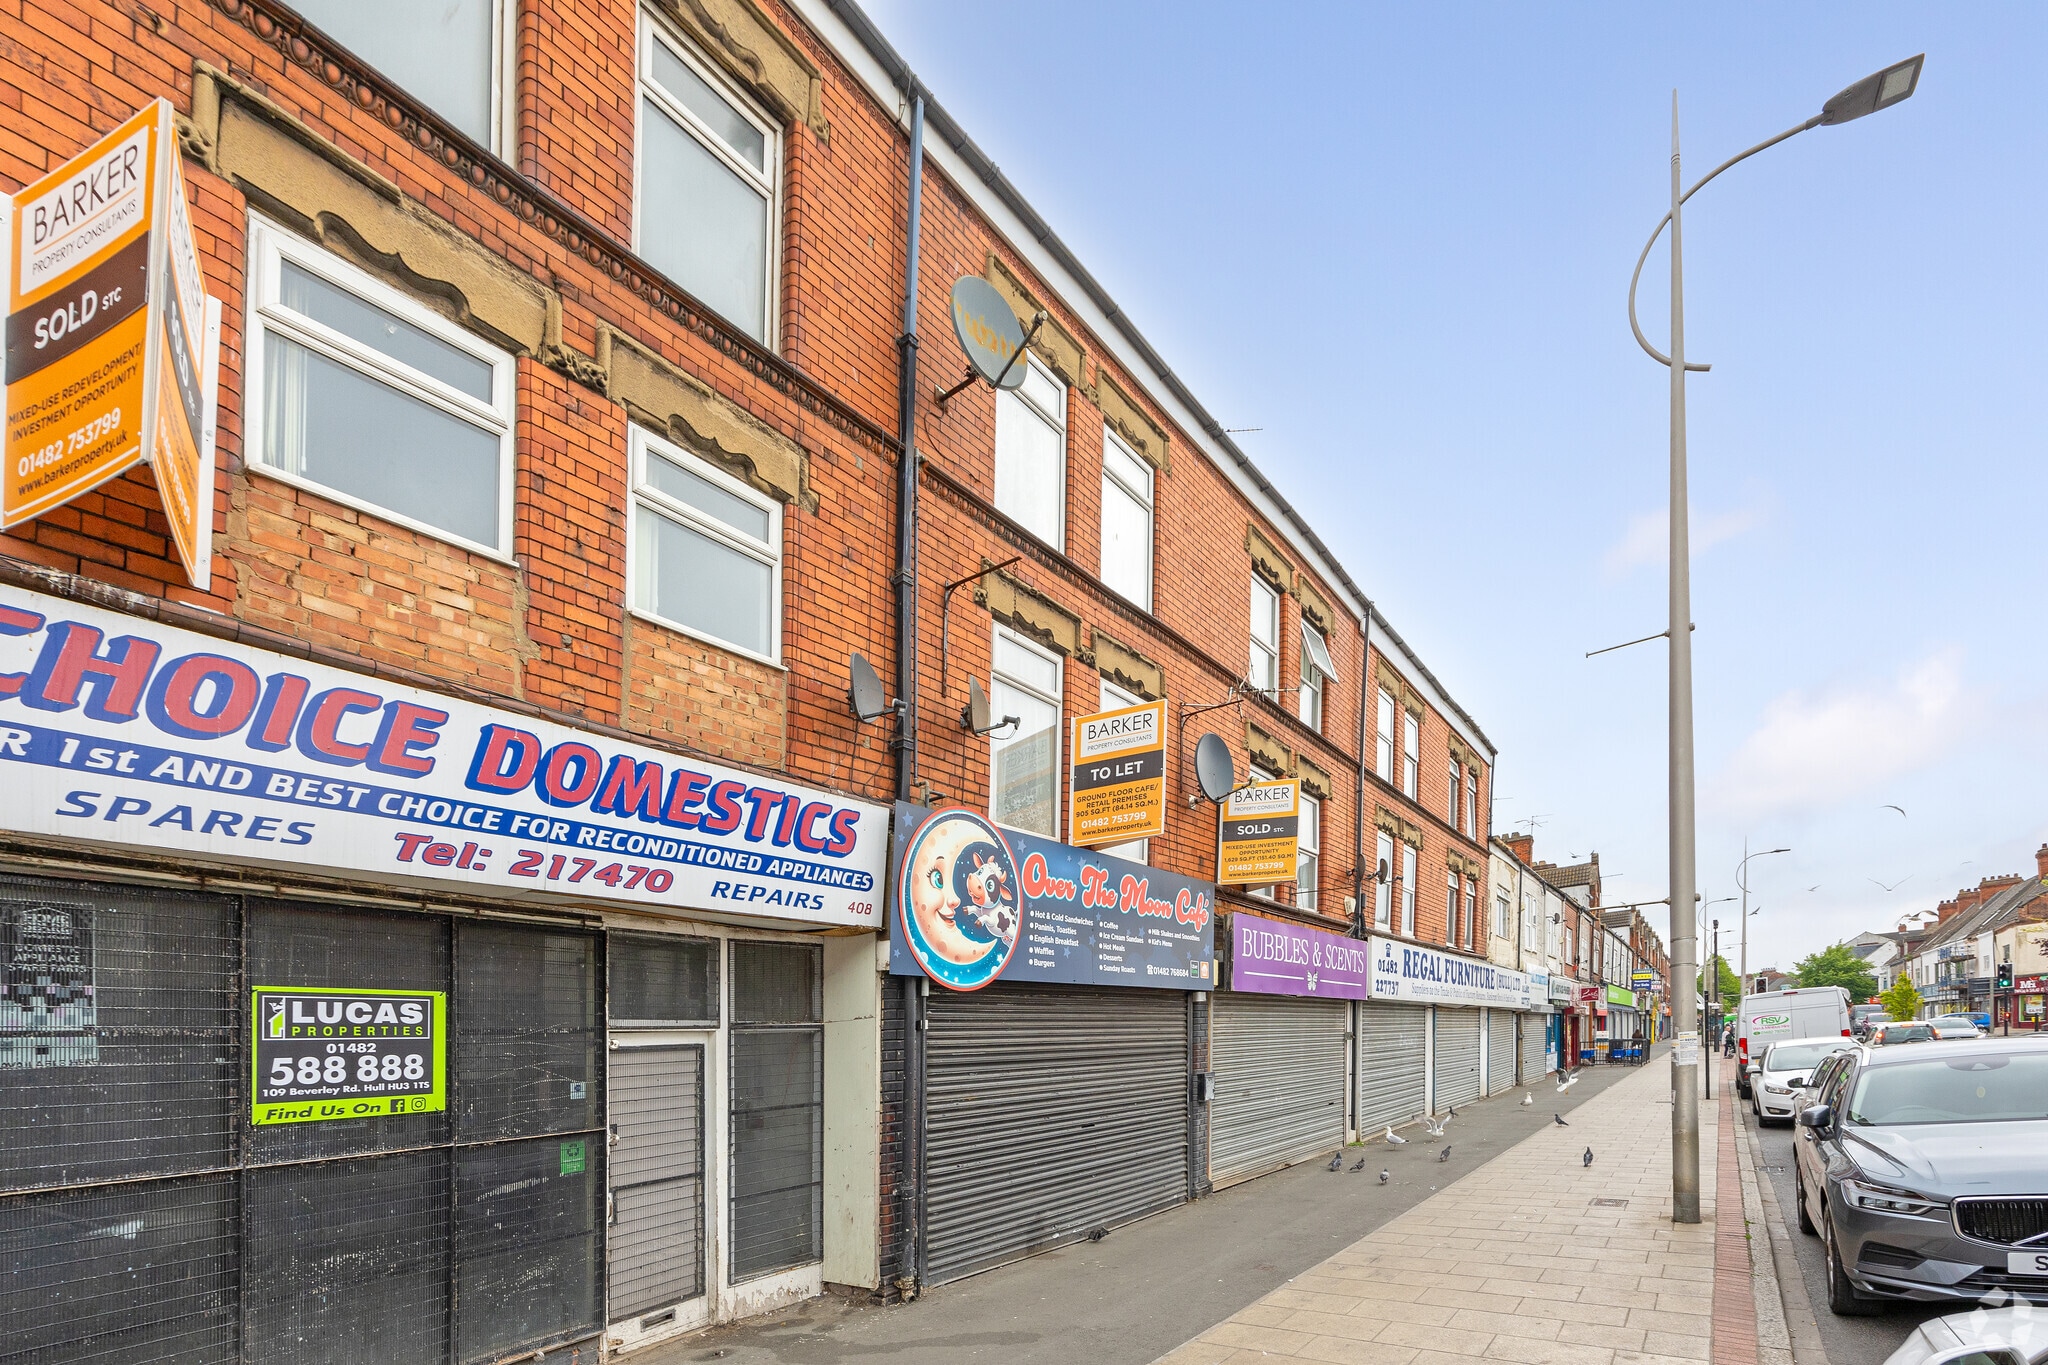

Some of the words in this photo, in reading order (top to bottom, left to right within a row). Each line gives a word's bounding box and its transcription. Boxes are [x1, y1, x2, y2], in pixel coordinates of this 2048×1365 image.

[34, 144, 138, 245] BARKER
[32, 240, 75, 276] PROPERTY
[77, 199, 136, 250] CONSULTANTS
[34, 290, 98, 349] SOLD
[102, 287, 122, 310] STC
[8, 392, 59, 427] MIXED-USE
[62, 338, 145, 399] REDEVELOPMENT/
[12, 403, 71, 442] INVESTMENT
[74, 363, 138, 412] OPPORTUNITY
[18, 440, 63, 476] 01482
[67, 407, 121, 455] 753799
[18, 430, 128, 496] www.barkerproperty.uk
[1088, 713, 1153, 740] BARKER
[1087, 741, 1113, 751] PROPERTY
[1114, 734, 1153, 746] CONSULTANTS
[1090, 766, 1111, 781] TO
[1115, 760, 1144, 777] LET
[465, 723, 861, 858] DOMESTICS
[1077, 792, 1107, 803] GROUND
[1109, 787, 1133, 797] FLOOR
[1135, 783, 1159, 792] CAFE/
[1235, 787, 1290, 803] BARKER
[1076, 809, 1089, 818] 905
[1090, 806, 1110, 815] SQ.FT
[1112, 803, 1133, 812] (84.14
[1135, 799, 1159, 808] SQ.M.)
[1086, 799, 1110, 808] RETAIL
[1112, 793, 1148, 804] PREMISES
[1257, 803, 1289, 811] CONSULTANTS
[55, 790, 316, 846] SPARES
[59, 738, 140, 773] 1st
[151, 755, 252, 791] AND
[266, 773, 371, 809] BEST
[377, 792, 503, 830] CHOICE
[510, 815, 570, 842] FOR
[576, 827, 761, 872] RECONDITIONED
[766, 859, 872, 890] APPLIANCES
[1081, 817, 1109, 829] 01482
[1112, 811, 1146, 824] 753799
[1081, 820, 1152, 836] www.barkerproperty.uk
[1237, 824, 1271, 835] SOLD
[1225, 842, 1256, 850] MIXED-USE
[1238, 848, 1280, 856] OPPORTUNITY
[394, 832, 493, 871] Tel:
[508, 848, 674, 894] 217470
[1228, 863, 1252, 872] 01482
[1254, 861, 1285, 871] 753799
[1228, 868, 1288, 877] www.barkerproperty.uk
[710, 880, 825, 911] REPAIRS
[1022, 852, 1077, 900] Over
[1081, 864, 1118, 909] The
[1119, 874, 1174, 919] Moon
[1175, 887, 1210, 932] Café
[847, 901, 872, 916] 408
[1034, 910, 1046, 919] Hot
[1046, 912, 1051, 920] &
[1051, 912, 1064, 922] Cold
[1064, 915, 1094, 926] Sandwiches
[1103, 921, 1119, 930] Coffee
[1034, 922, 1056, 933] Paninis,
[1056, 925, 1077, 935] Toasties
[1160, 930, 1174, 938] Shakes
[1181, 933, 1201, 942] Smoothies
[1034, 934, 1055, 944] English
[1055, 936, 1079, 947] Breakfast
[1103, 932, 1111, 940] Ice
[1111, 933, 1126, 942] Cream
[1126, 935, 1144, 944] Sundaes
[1161, 940, 1173, 948] Menu
[1033, 946, 1055, 956] Waffles
[1112, 943, 1126, 952] Meals
[1242, 927, 1309, 966] BUBBLES
[1312, 941, 1322, 967] &
[1325, 943, 1364, 974] SCENTS
[1033, 958, 1056, 968] Burgers
[1103, 954, 1123, 962] Desserts
[1103, 964, 1121, 973] Sunday
[1121, 965, 1136, 973] Roasts
[1153, 966, 1170, 976] 01482
[1377, 959, 1398, 975] 01482
[1402, 948, 1443, 982] REGAL
[1444, 958, 1495, 990] FURNITURE
[1375, 979, 1399, 997] 227737
[292, 1001, 423, 1024] LUCAS
[1761, 1016, 1781, 1024] RSV
[291, 1026, 424, 1037] PROPERTIES
[326, 1043, 377, 1054] 01482
[269, 1055, 347, 1086] 588
[356, 1053, 425, 1082] 888
[262, 1088, 286, 1097] 109
[289, 1086, 340, 1096] Beverley
[343, 1085, 361, 1093] Rd.
[364, 1083, 385, 1092] Hull
[387, 1082, 410, 1091] HU3
[413, 1081, 430, 1089] 1TS
[265, 1106, 314, 1120] Find
[320, 1105, 345, 1116] Us
[352, 1103, 381, 1114] On
